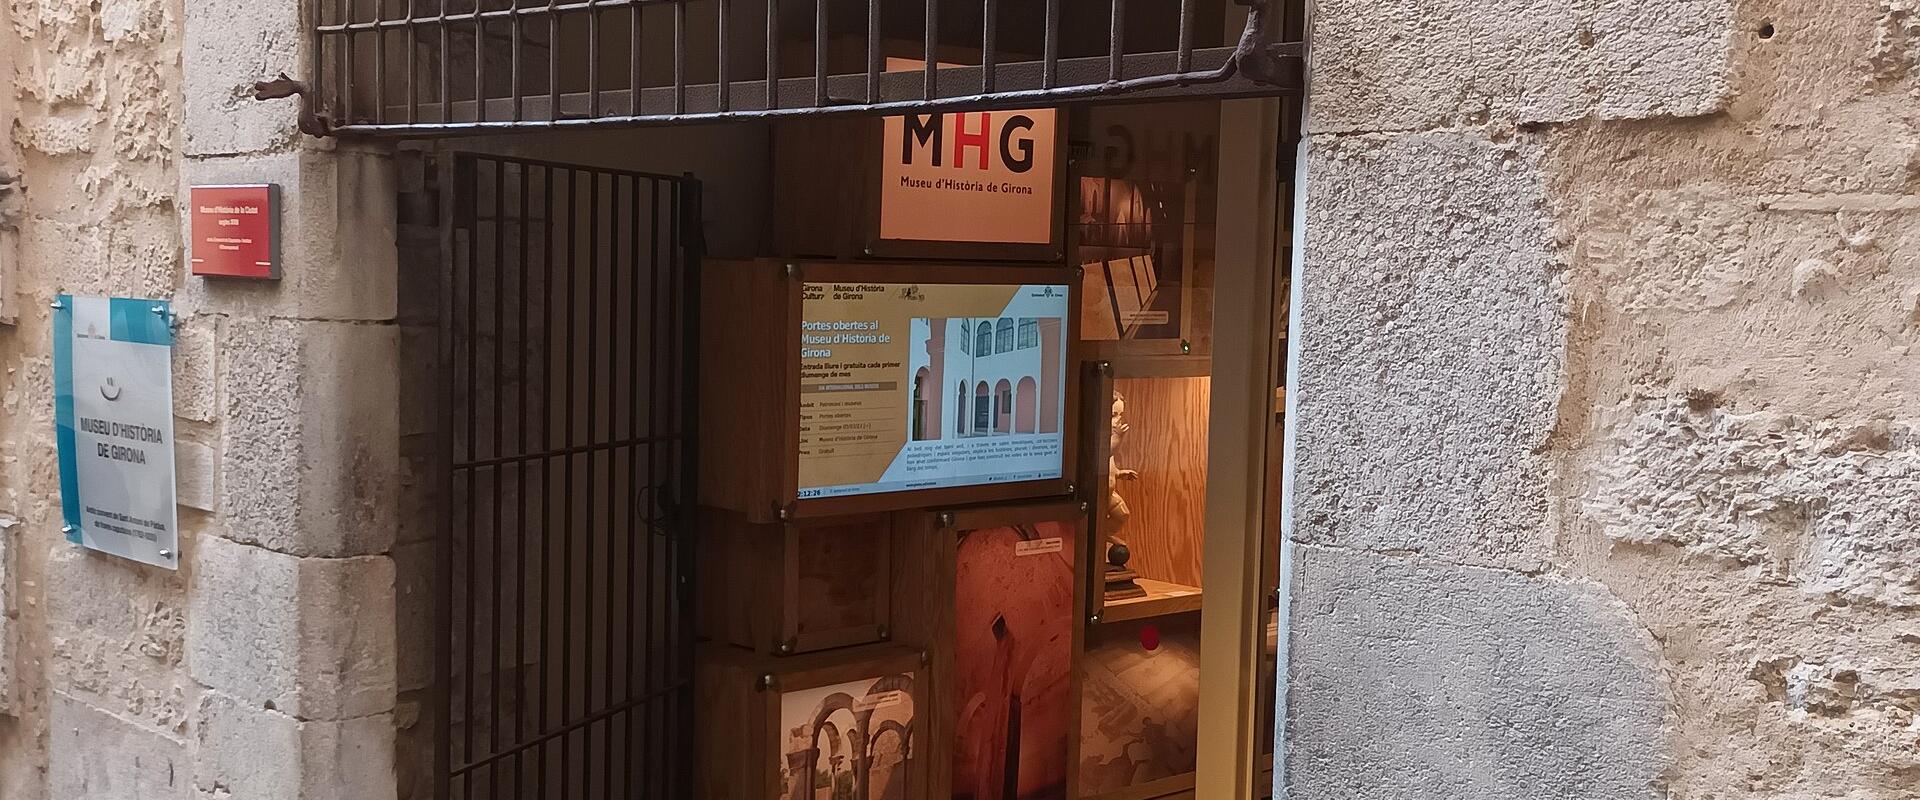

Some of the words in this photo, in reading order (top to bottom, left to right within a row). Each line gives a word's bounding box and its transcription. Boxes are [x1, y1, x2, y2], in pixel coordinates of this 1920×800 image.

[902, 112, 1035, 174] MHG
[900, 176, 932, 189] Museu
[935, 178, 984, 193] d'Història
[986, 182, 998, 193] de
[1001, 182, 1032, 195] Girona
[802, 321, 831, 330] Portes
[833, 320, 868, 330] obertes
[870, 320, 878, 330] al
[802, 334, 831, 344] Museu
[878, 334, 890, 343] de
[802, 348, 831, 358] Girona
[80, 417, 110, 436] MUSEU
[112, 422, 163, 444] D'HISTÒRIA
[98, 442, 109, 458] DE
[111, 444, 146, 464] GIRONA
